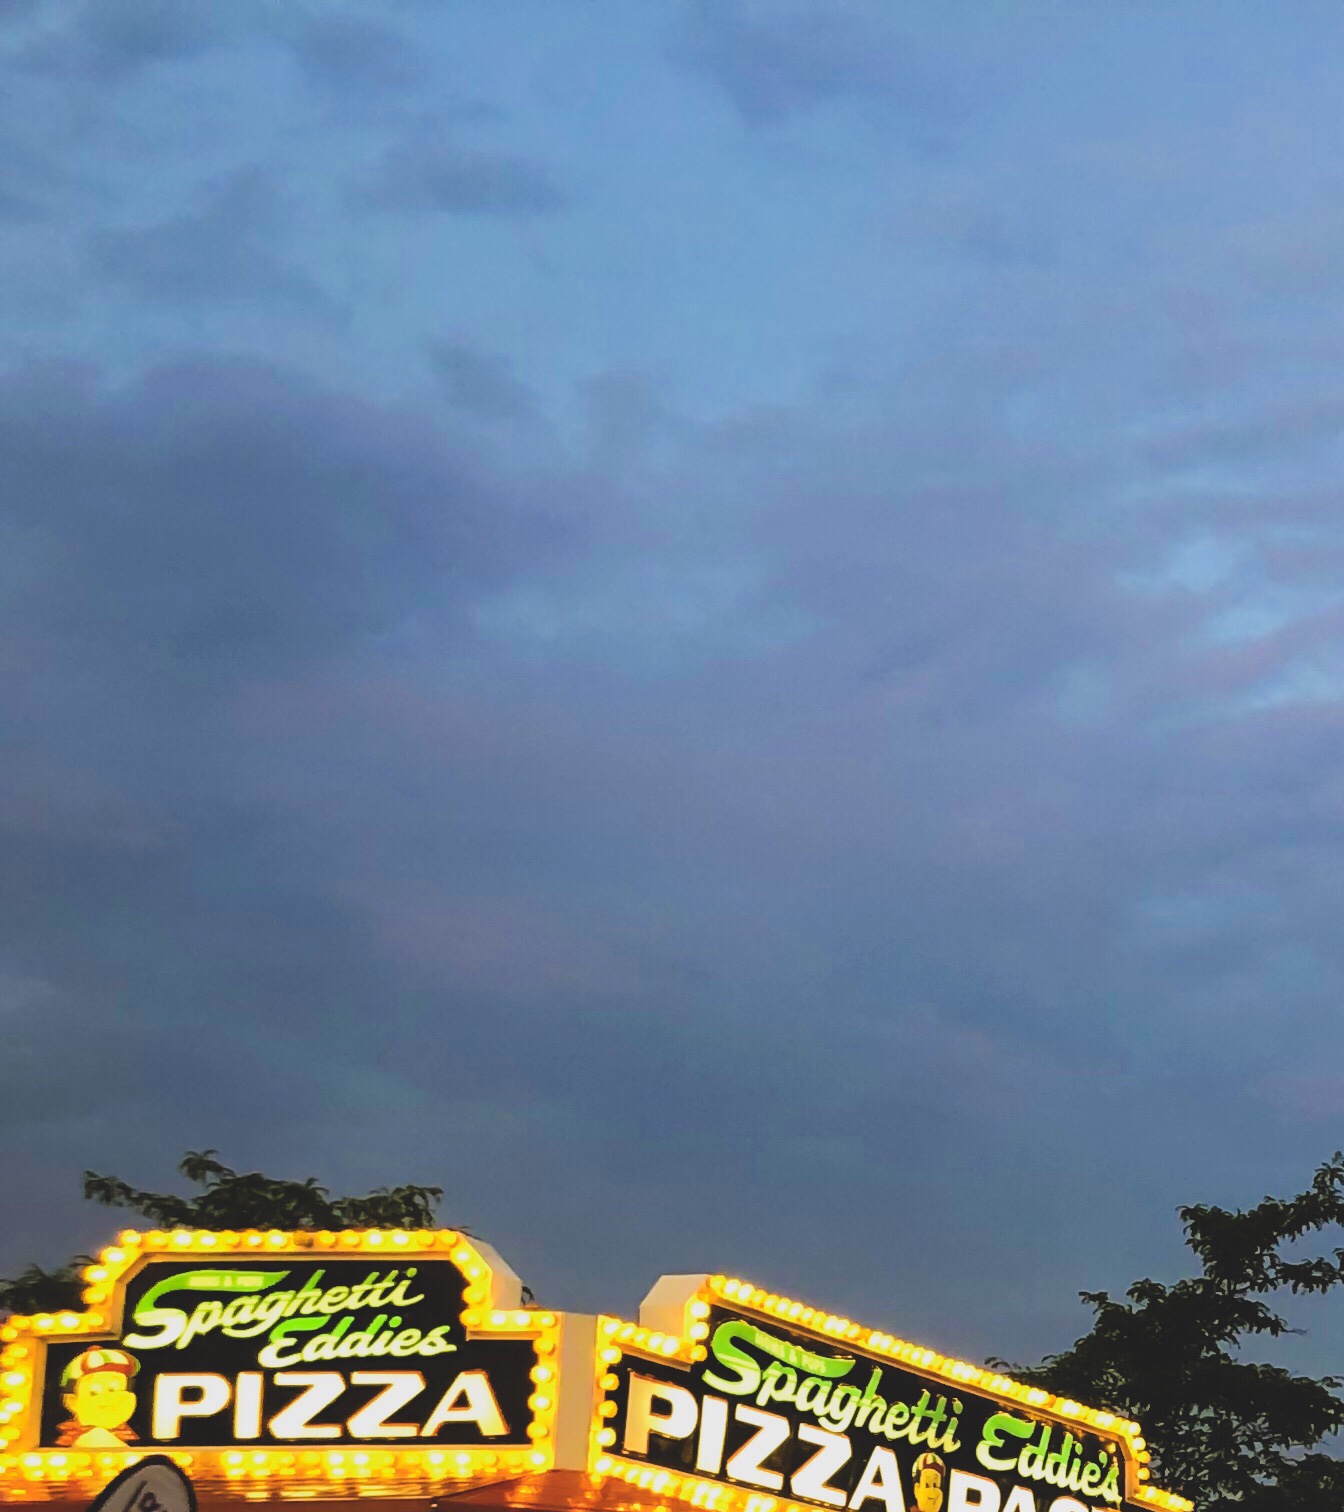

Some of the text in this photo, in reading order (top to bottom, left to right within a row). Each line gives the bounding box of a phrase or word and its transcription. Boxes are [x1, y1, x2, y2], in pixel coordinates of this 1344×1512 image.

[123, 1268, 424, 1348] Spaghetti
[258, 1314, 457, 1368] Eddies
[151, 1369, 510, 1440] PIZZA
[702, 1319, 1122, 1506] Spaghetti Eddie's
